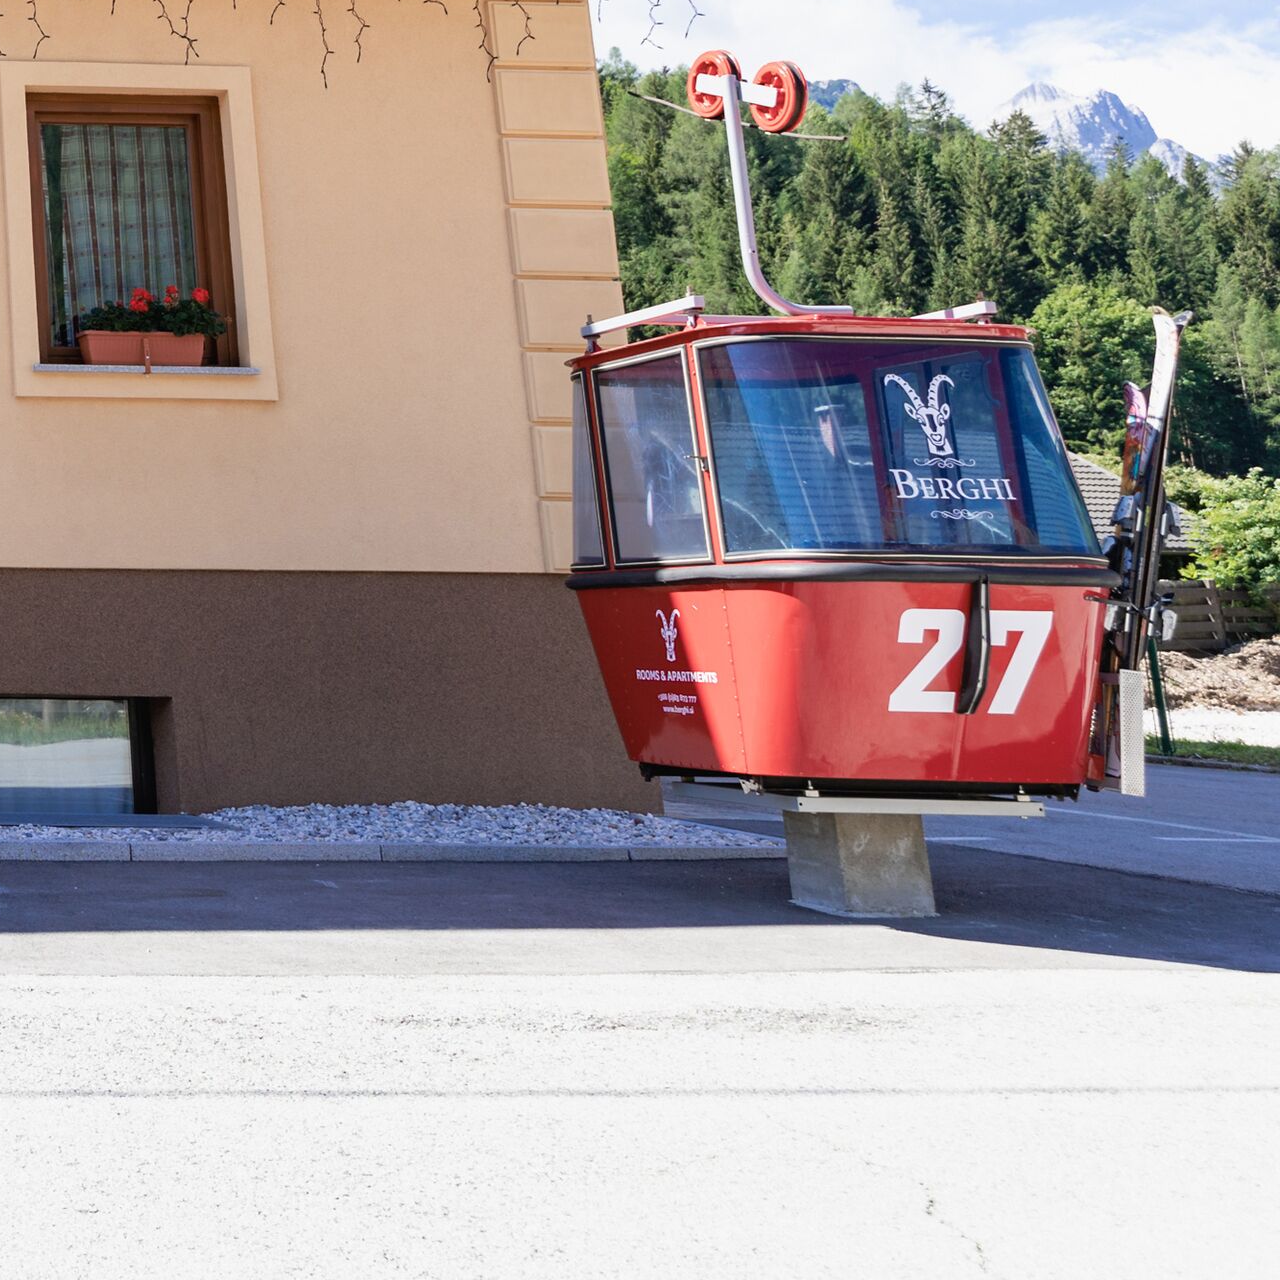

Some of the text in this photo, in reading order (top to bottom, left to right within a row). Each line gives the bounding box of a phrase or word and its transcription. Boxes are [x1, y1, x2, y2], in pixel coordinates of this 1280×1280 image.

[636, 669, 718, 684] ROOMS & APARTMENTS
[888, 608, 1053, 714] 27
